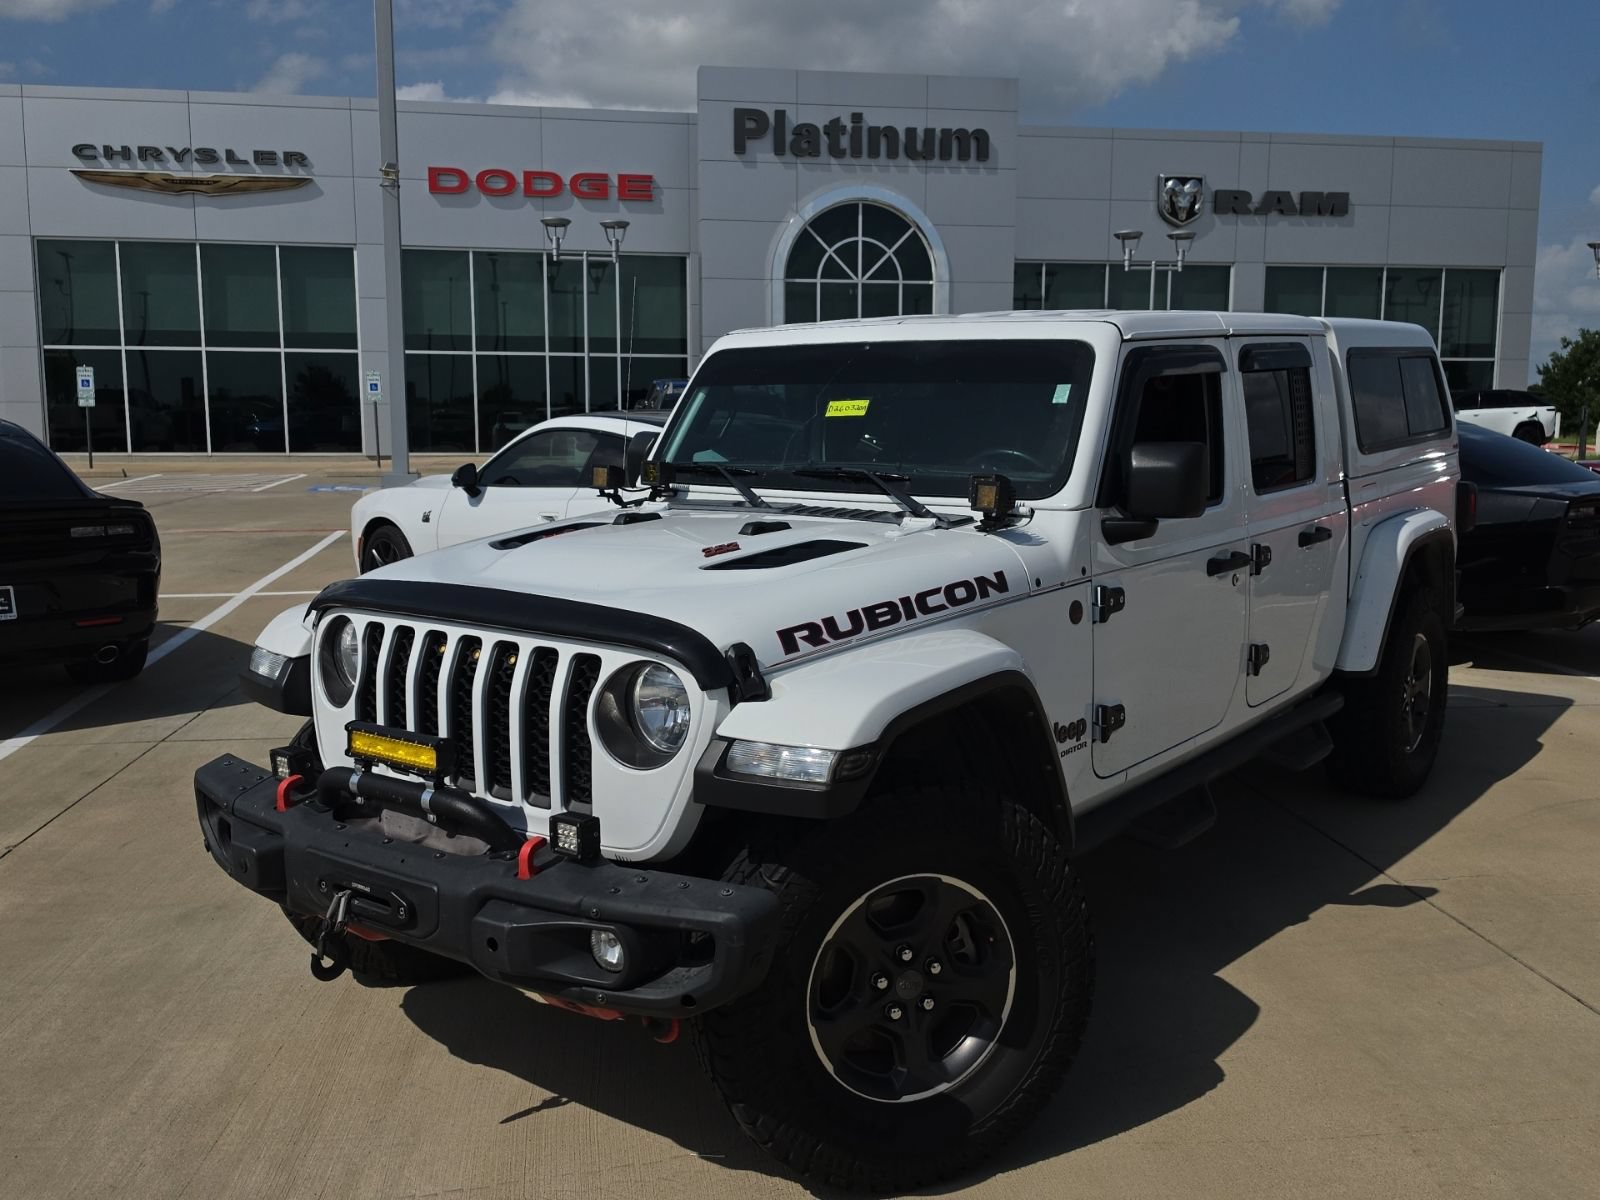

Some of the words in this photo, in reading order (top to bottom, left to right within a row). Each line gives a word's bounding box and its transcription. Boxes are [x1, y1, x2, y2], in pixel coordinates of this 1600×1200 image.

[733, 107, 990, 162] Platinum
[71, 143, 309, 168] CHRYSLER
[427, 166, 655, 202] DODGE
[1214, 189, 1350, 217] RAM
[775, 570, 1010, 656] RUBICON
[1060, 741, 1088, 758] DIATOR
